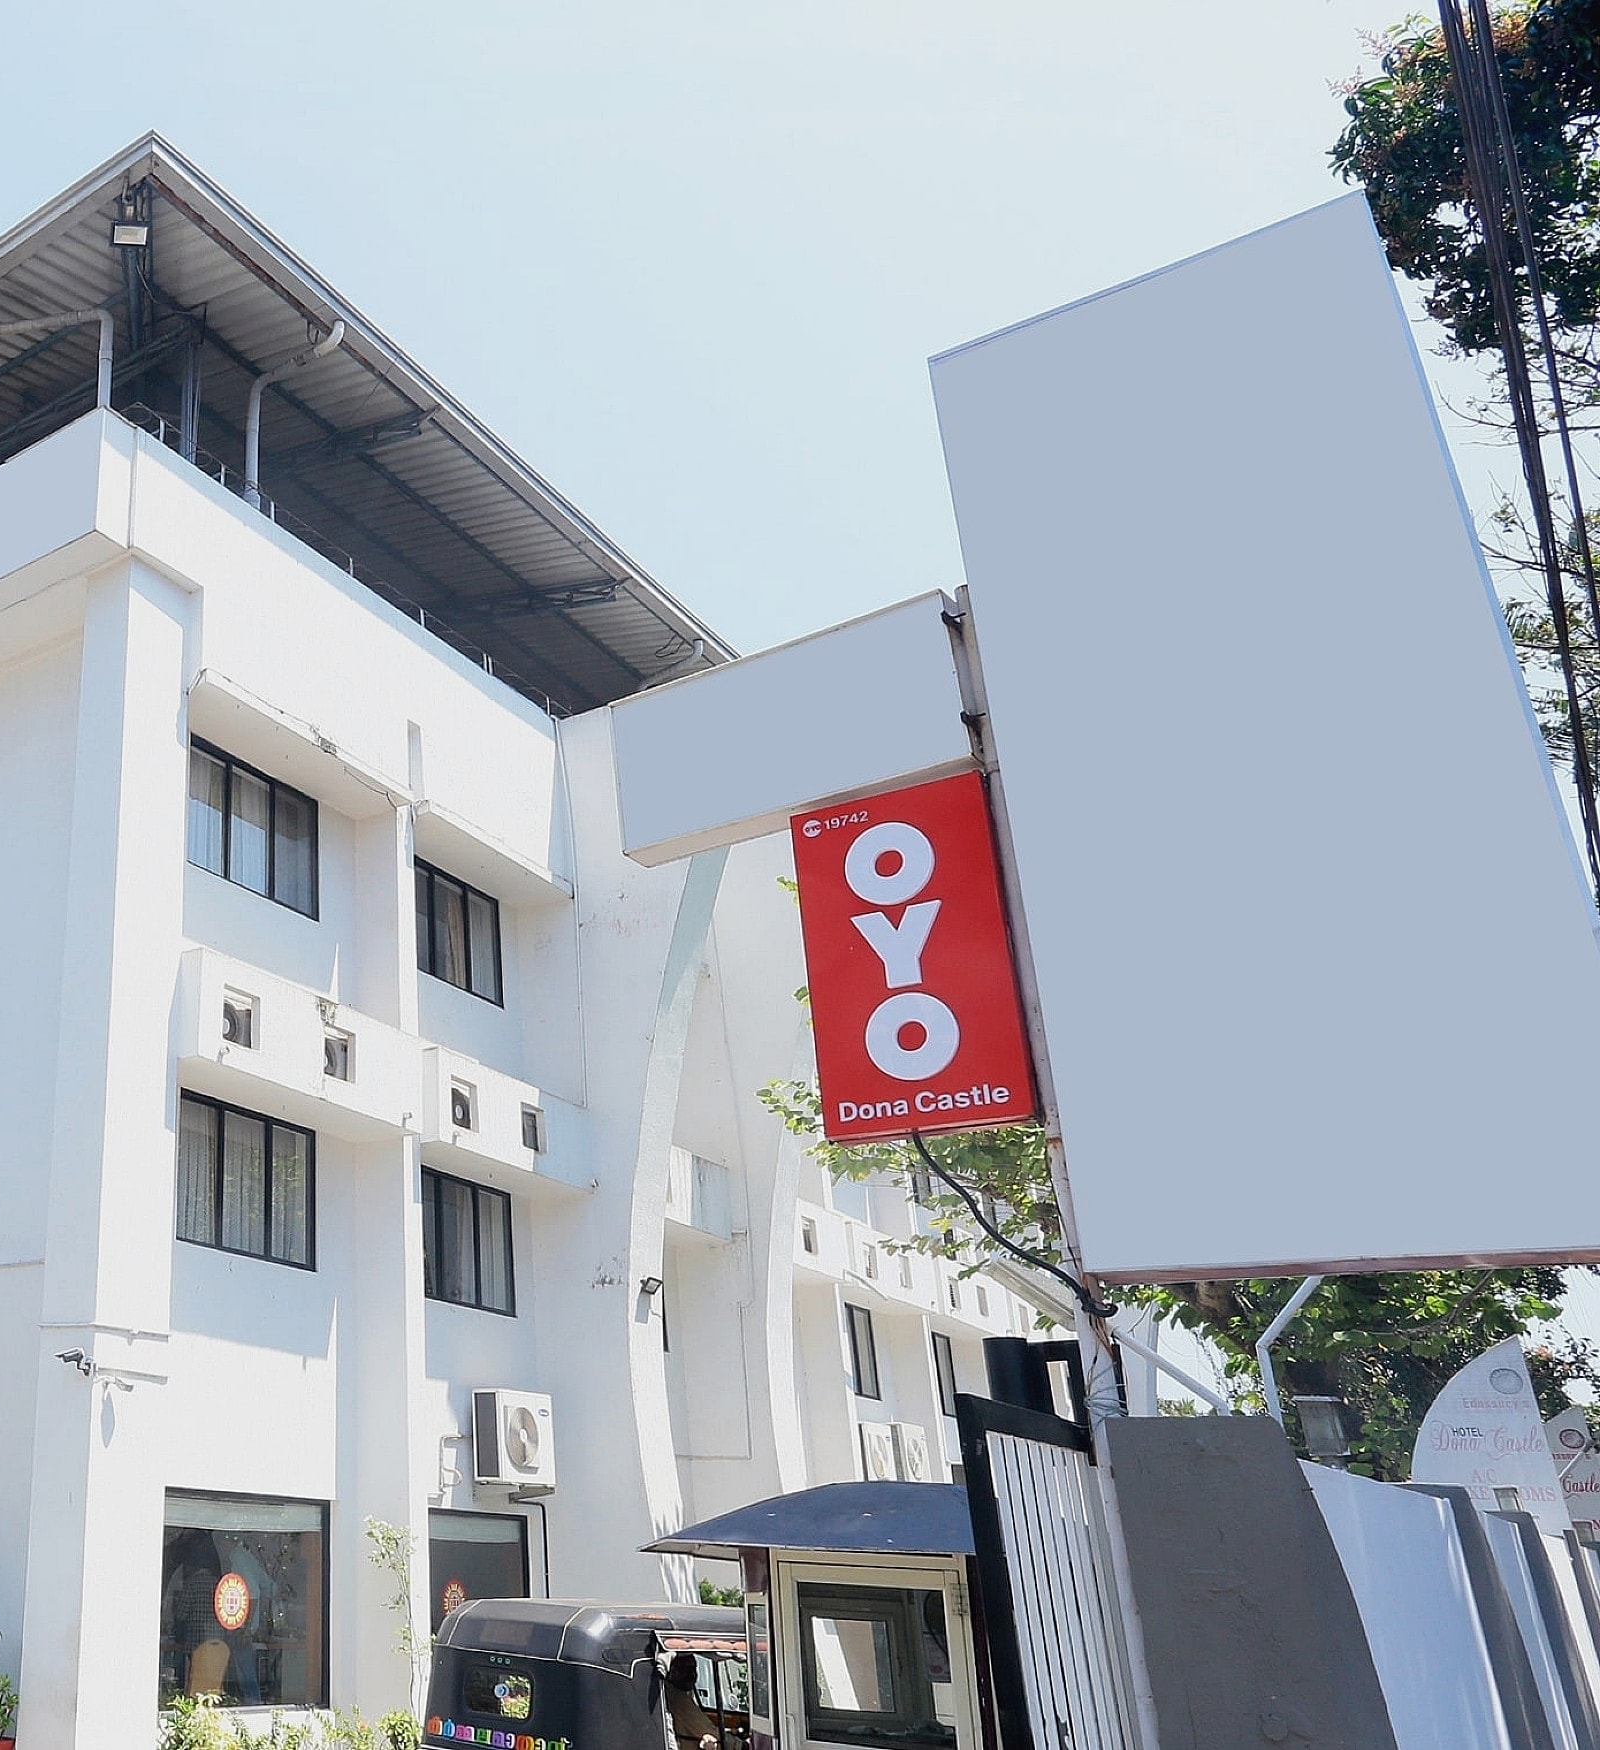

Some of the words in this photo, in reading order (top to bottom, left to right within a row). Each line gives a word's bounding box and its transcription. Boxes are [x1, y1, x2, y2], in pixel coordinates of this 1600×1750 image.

[824, 810, 869, 830] 19742
[844, 821, 961, 1081] OYO
[838, 1098, 909, 1124] Dona
[914, 1082, 1011, 1114] Castle
[1430, 1420, 1481, 1451] Dona
[1485, 1424, 1545, 1461] Castle
[1452, 1427, 1484, 1438] HOTEL
